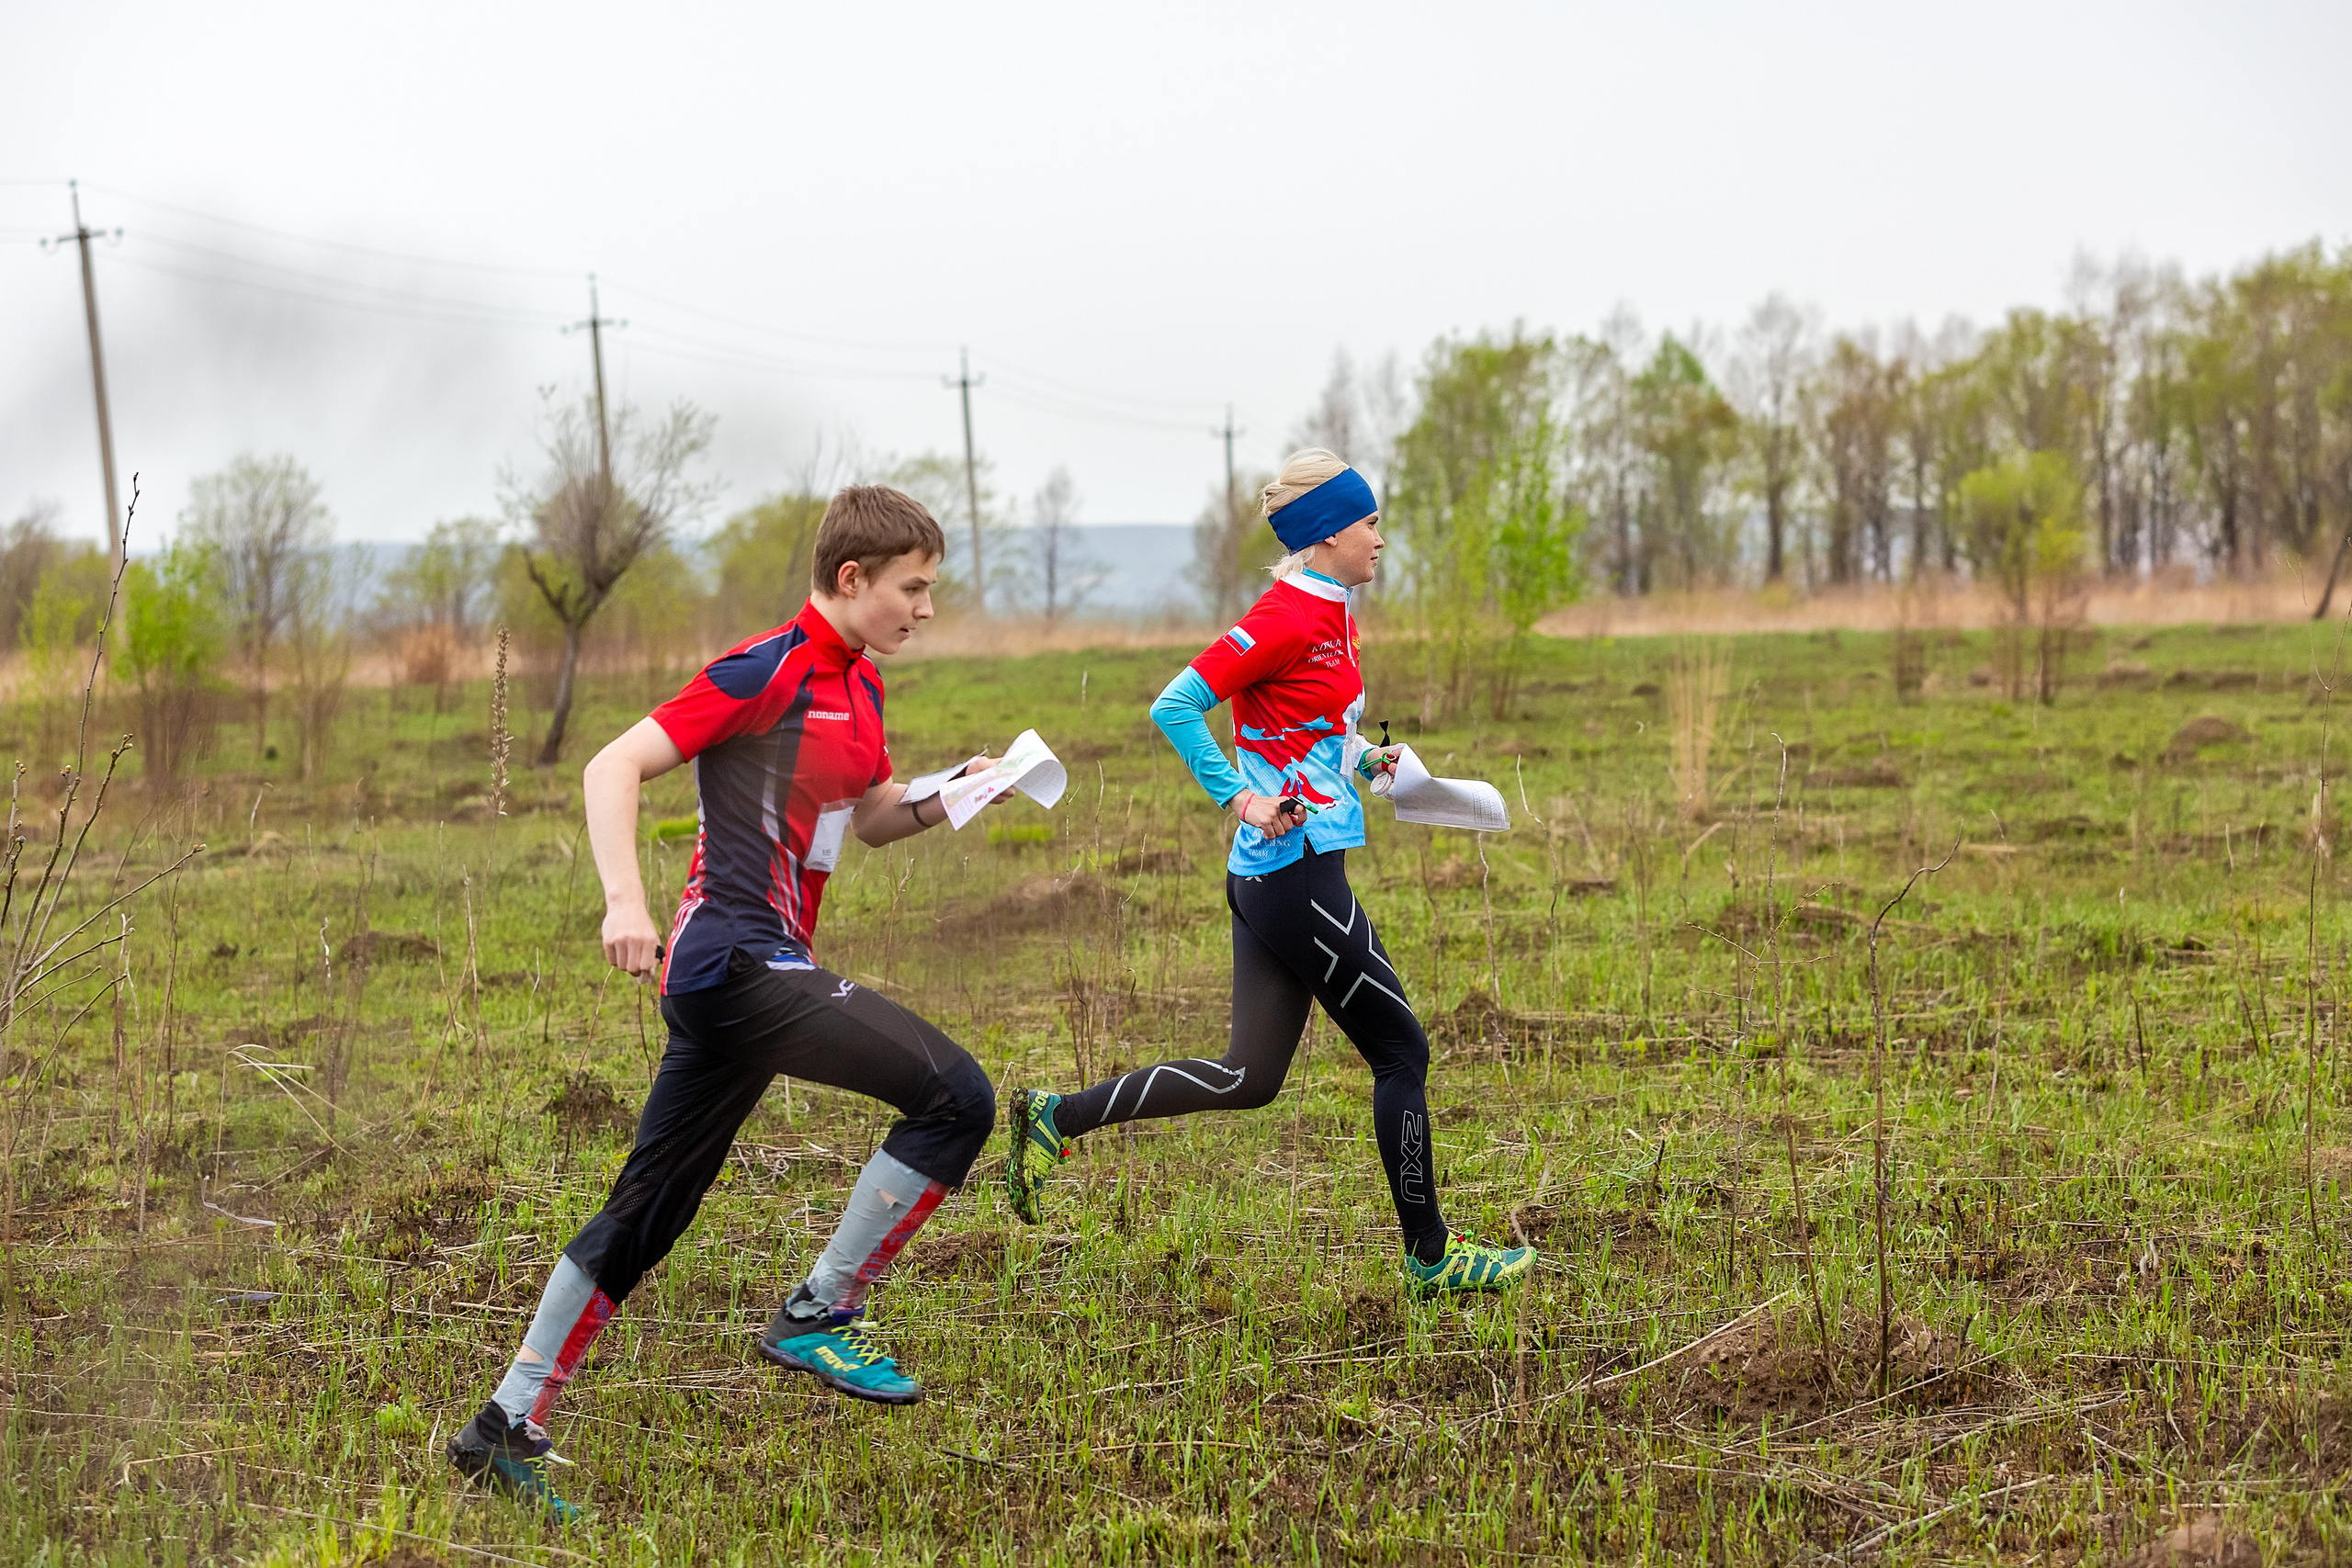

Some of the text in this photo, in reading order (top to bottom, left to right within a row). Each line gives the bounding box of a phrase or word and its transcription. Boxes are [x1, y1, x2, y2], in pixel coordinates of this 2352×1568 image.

[1325, 659, 1340, 668] TEAM
[807, 710, 850, 721] noname
[1400, 1110, 1426, 1204] 2XU
